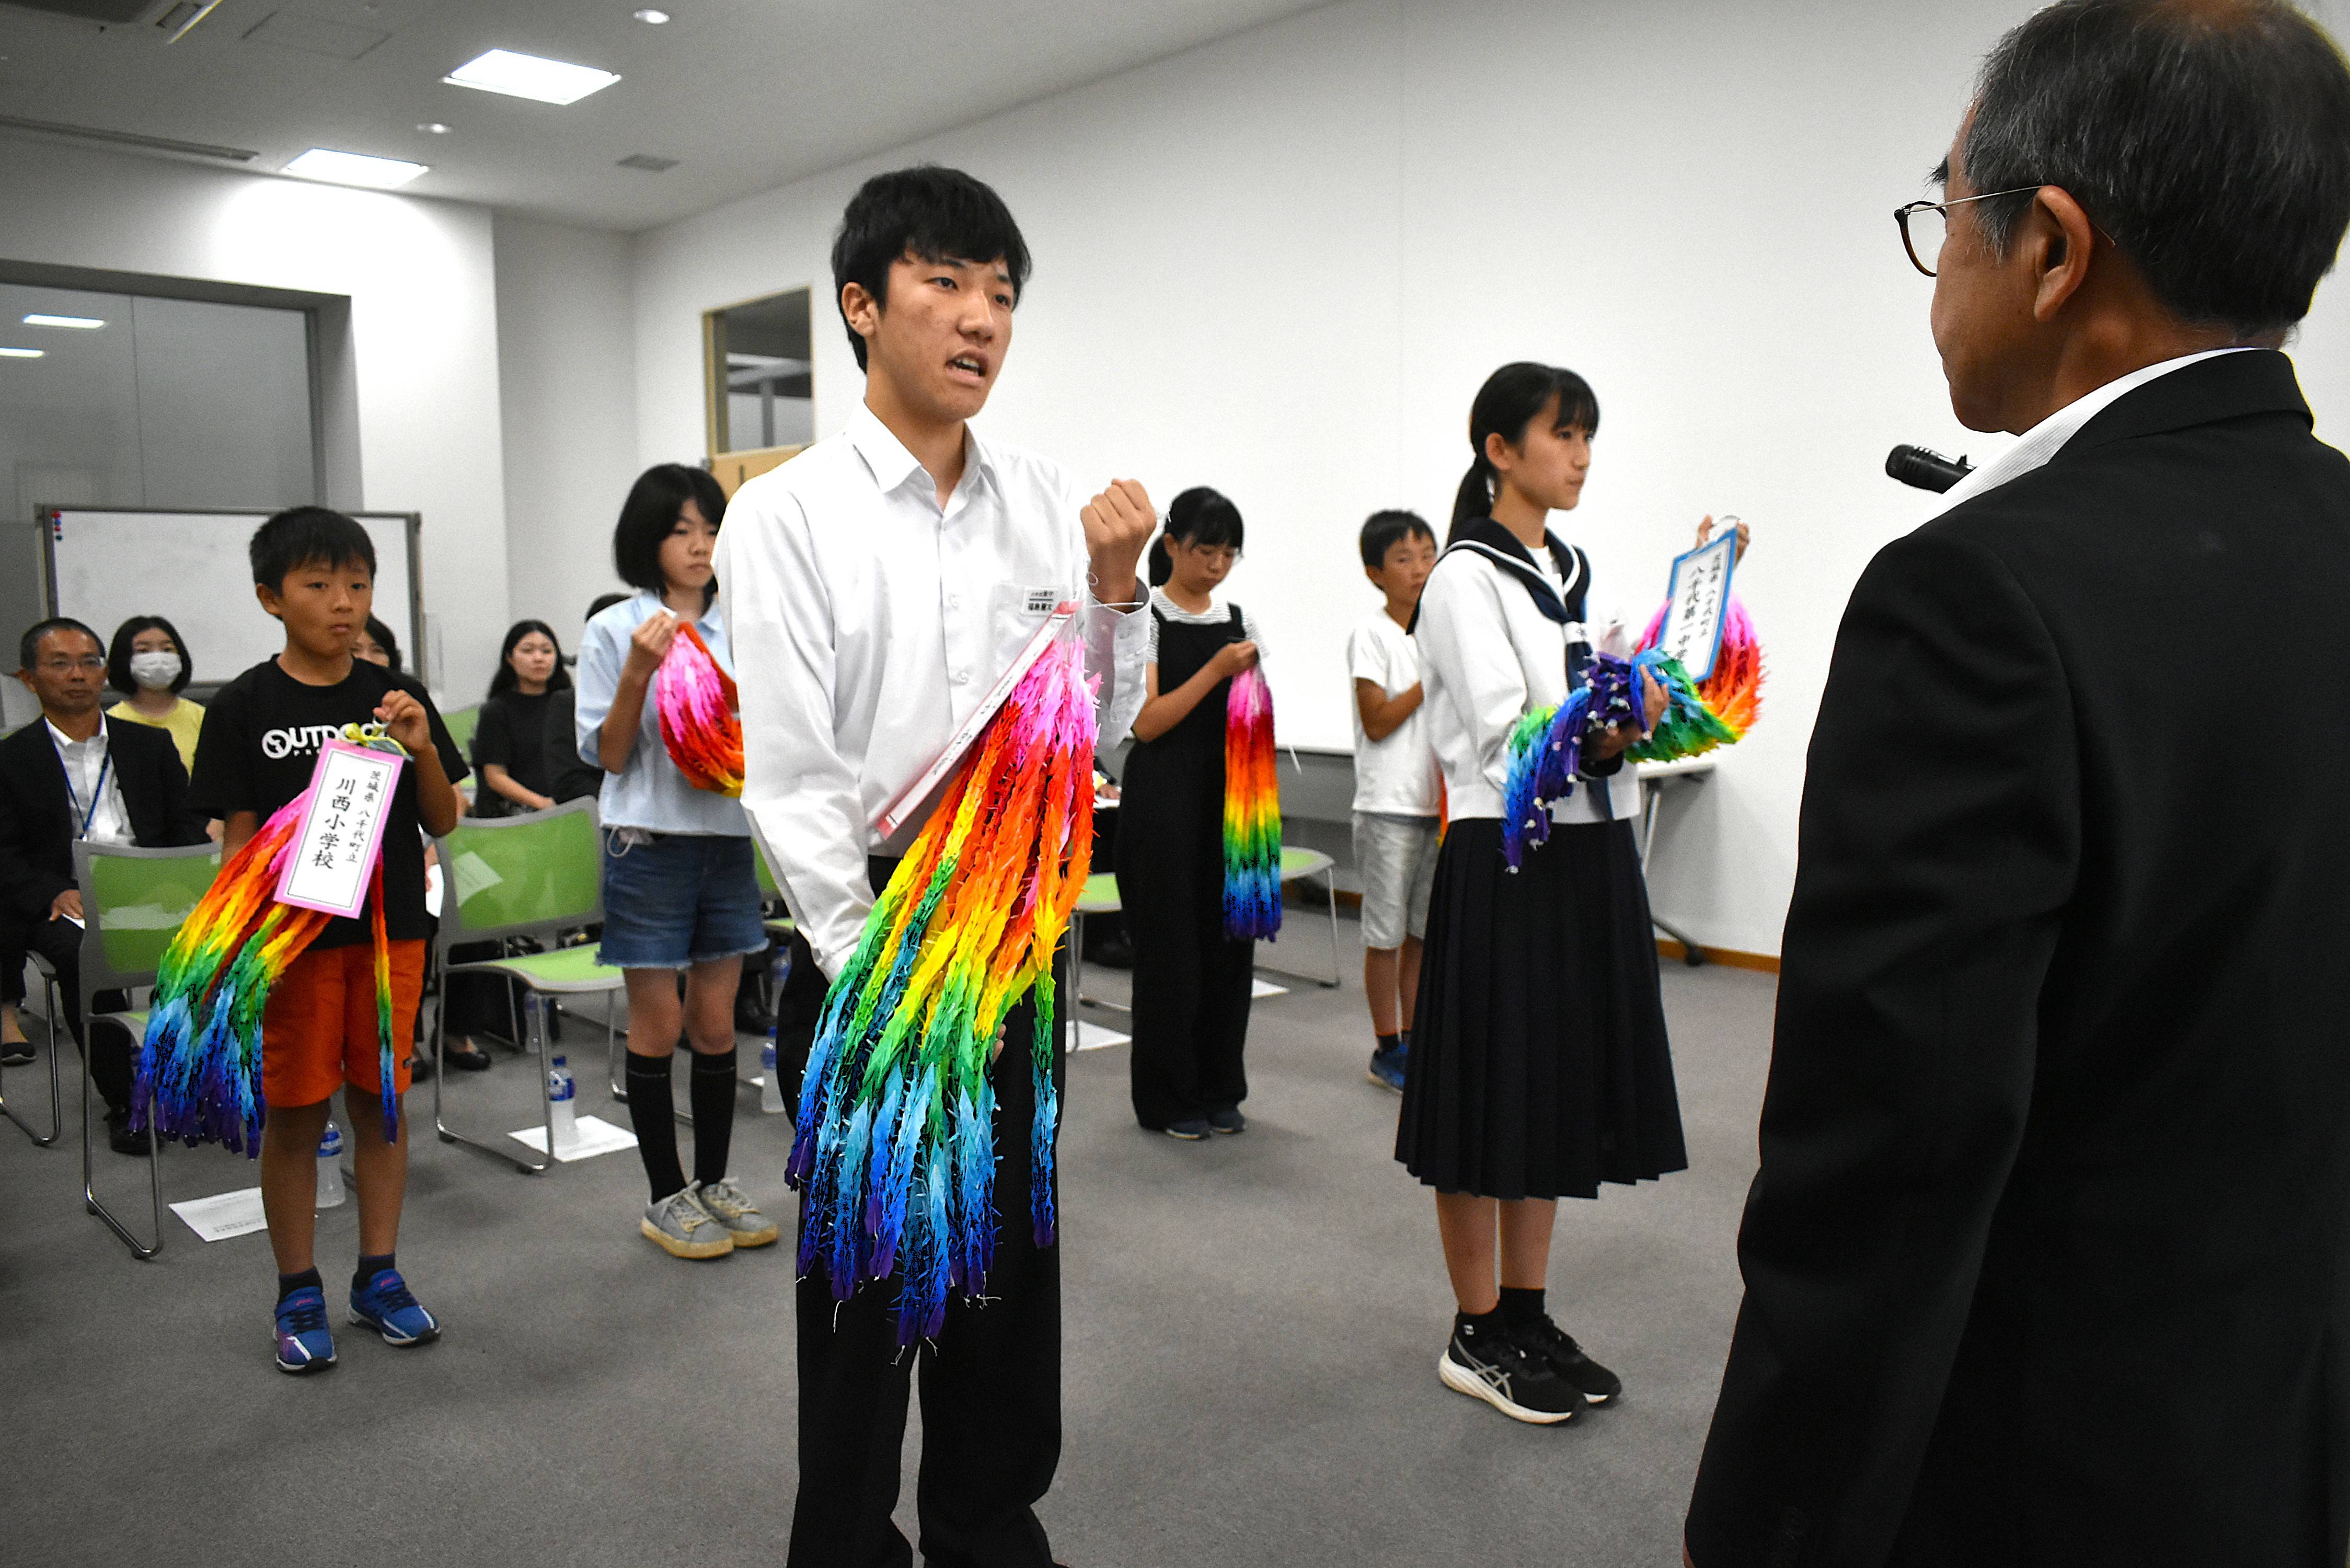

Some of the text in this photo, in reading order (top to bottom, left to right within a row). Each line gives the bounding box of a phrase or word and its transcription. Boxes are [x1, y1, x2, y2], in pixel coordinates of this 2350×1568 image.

[312, 778, 356, 870] 川西小学校
[345, 770, 381, 863] 茨城県 八千代町立
